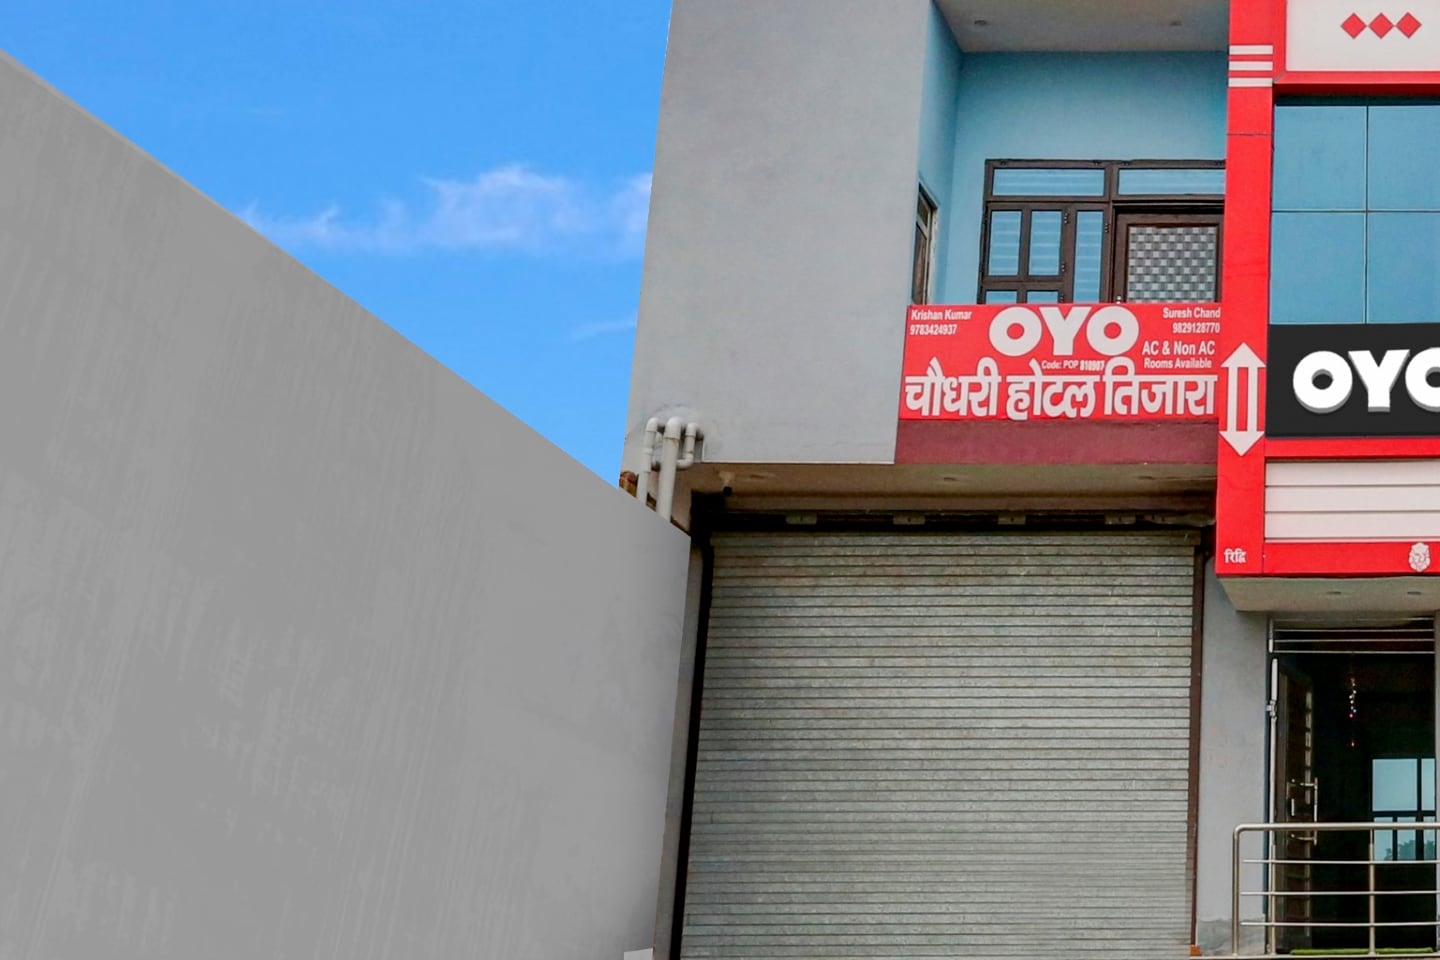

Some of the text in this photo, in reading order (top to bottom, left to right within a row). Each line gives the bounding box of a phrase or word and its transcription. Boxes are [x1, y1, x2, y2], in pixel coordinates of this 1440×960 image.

[911, 309, 972, 321] Krishan Kumar
[1163, 306, 1221, 318] Suresh Chand
[989, 306, 1140, 357] OYO
[1142, 340, 1215, 355] AC & Non AC
[1063, 359, 1079, 369] POP
[1144, 357, 1212, 369] Rooms Available
[905, 356, 1218, 421] चौधरी होटल तिजारा
